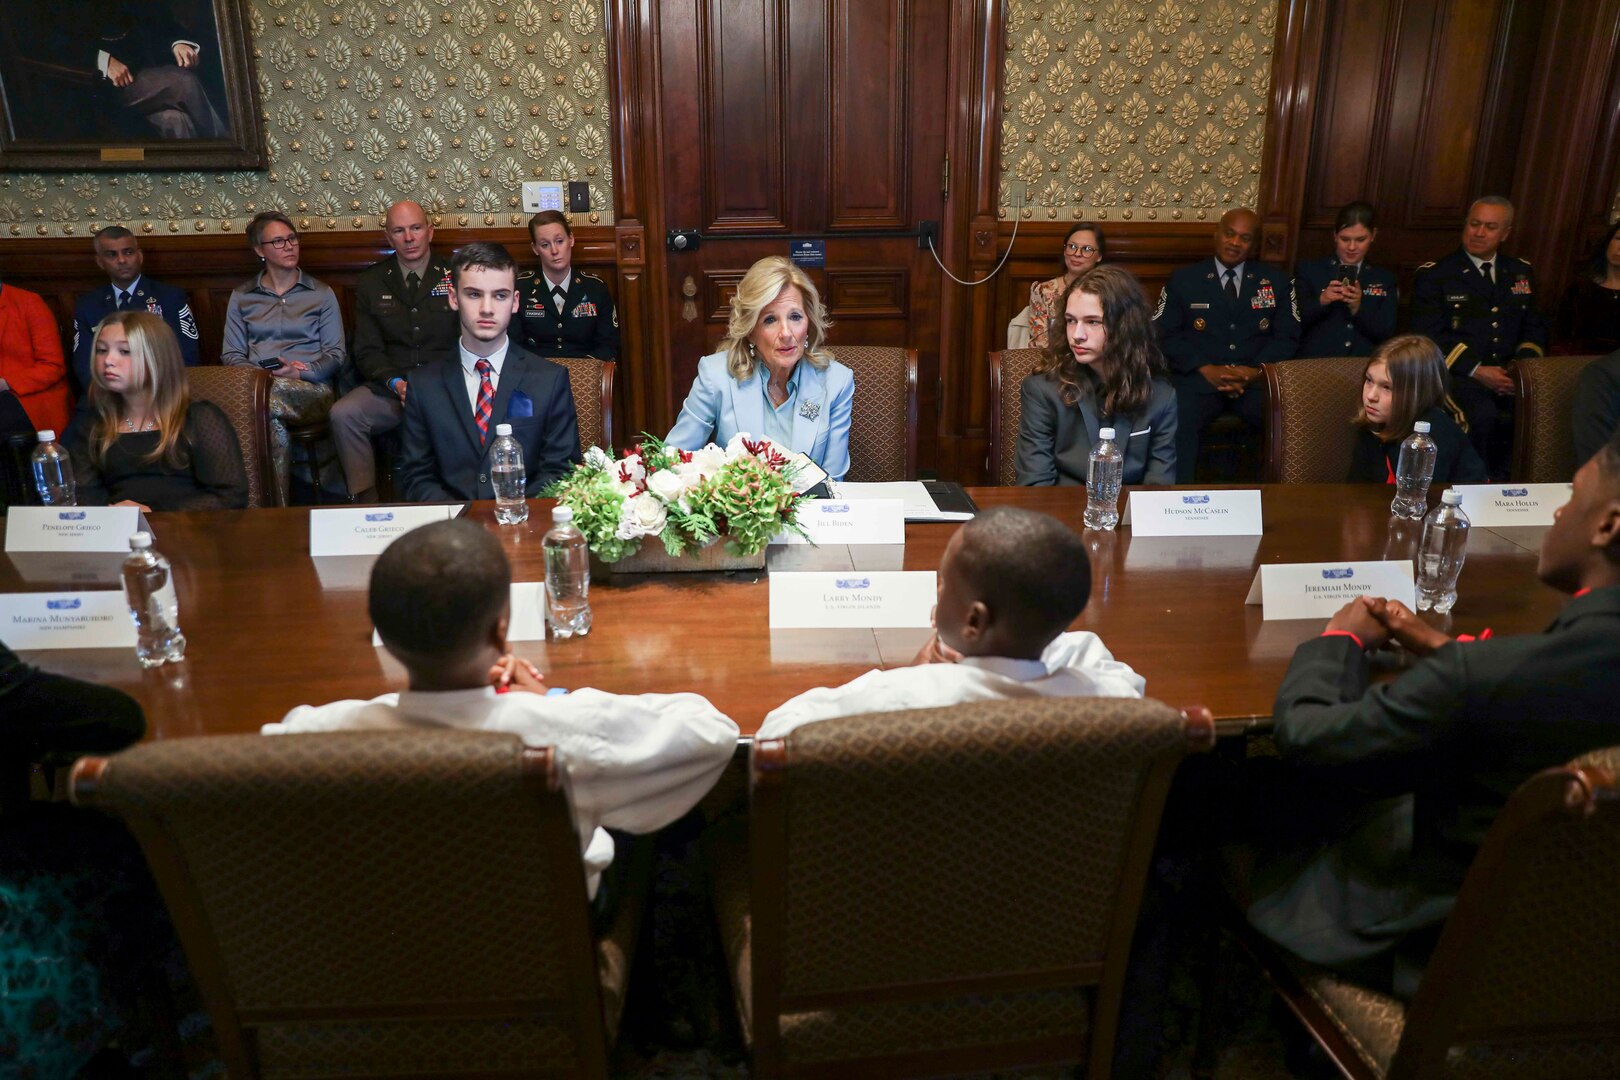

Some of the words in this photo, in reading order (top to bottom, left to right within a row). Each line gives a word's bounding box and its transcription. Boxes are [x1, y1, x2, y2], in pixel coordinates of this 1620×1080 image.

[1164, 507, 1192, 515] HUDSON
[42, 523, 74, 531] PENELOPE
[75, 523, 101, 531] GRIECO
[832, 519, 853, 527] BIDEN
[378, 525, 405, 533] GRIECO
[1305, 584, 1342, 593] JEREMIAH
[1343, 583, 1372, 592] MONDY
[823, 594, 849, 602] LARRY
[851, 593, 883, 602] MONDY
[13, 615, 47, 624] MARINA
